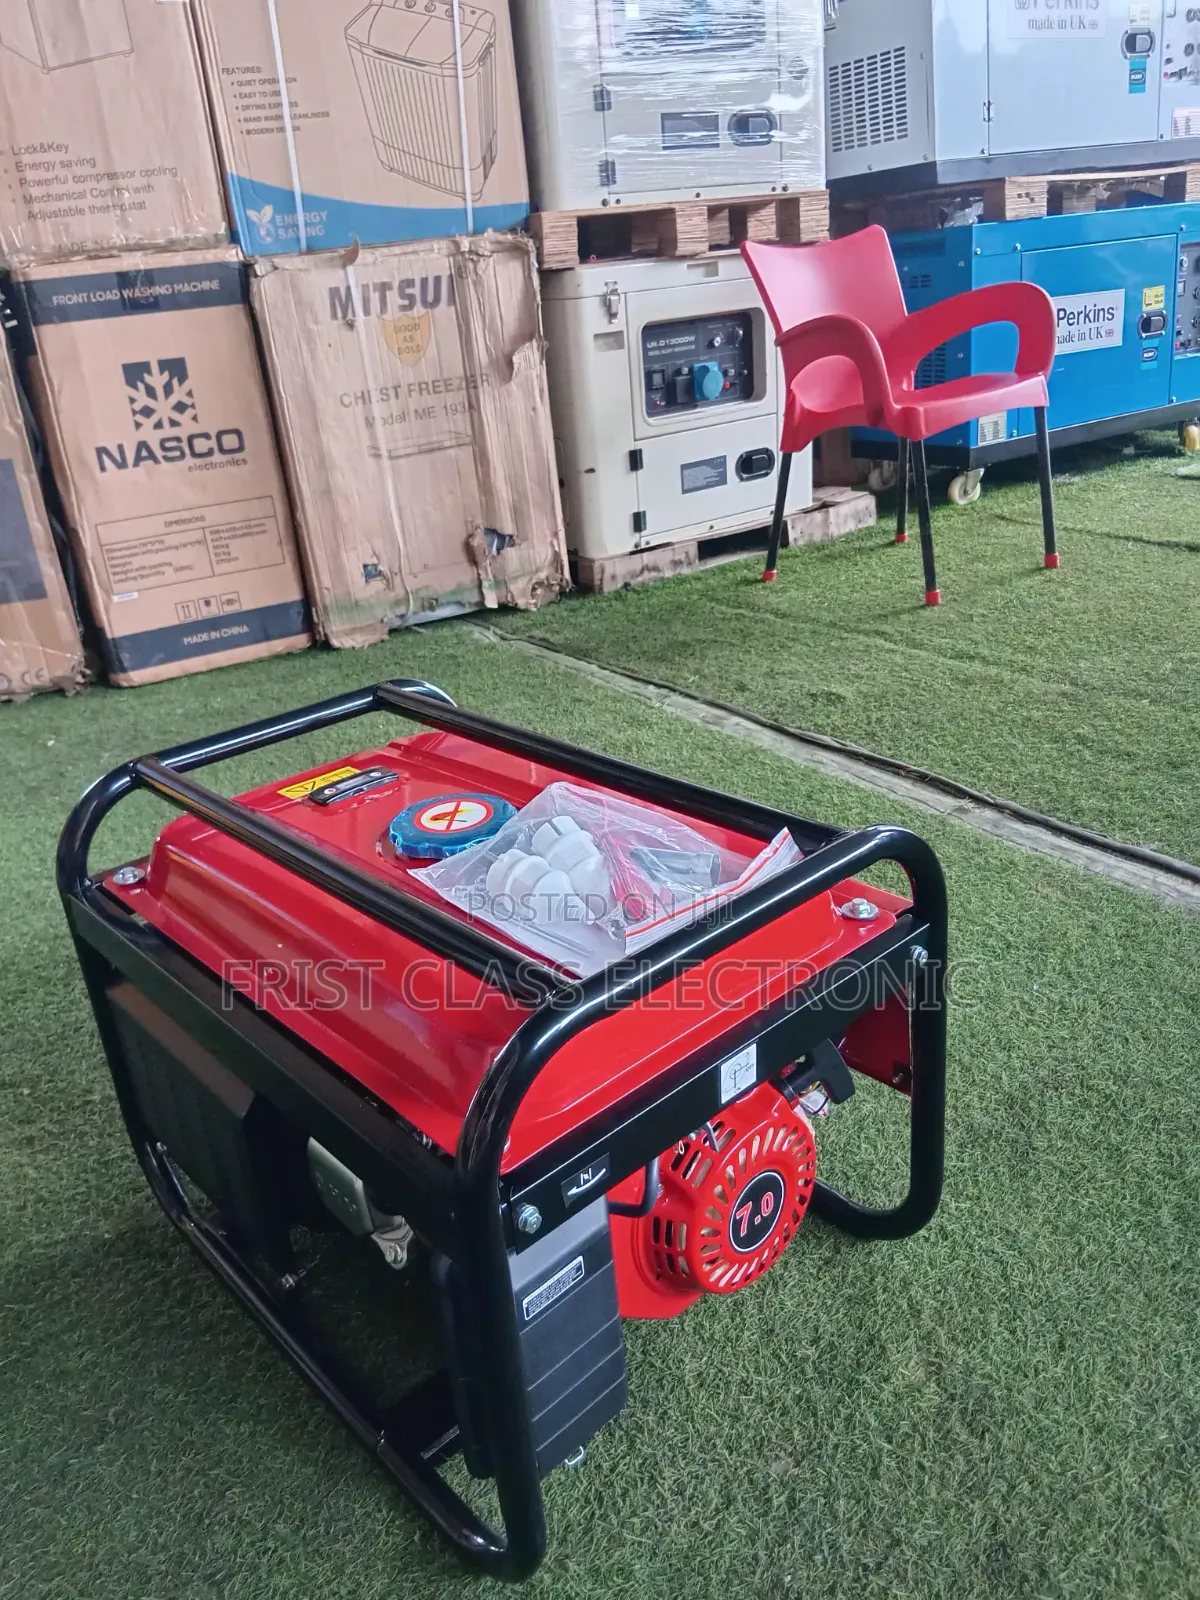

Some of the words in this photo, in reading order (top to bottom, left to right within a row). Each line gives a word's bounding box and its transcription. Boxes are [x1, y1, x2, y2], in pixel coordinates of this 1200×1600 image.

[1028, 15, 1055, 30] made
[1057, 15, 1067, 30] in
[1070, 14, 1086, 30] UK
[221, 66, 263, 75] FEATURES:
[236, 79, 256, 87] QUIET
[238, 91, 256, 99] EASY
[243, 115, 262, 123] HAND
[290, 111, 330, 120] LEANLINESS
[11, 142, 69, 156] Lock&Key
[15, 159, 57, 173] Energy
[60, 156, 96, 168] saving
[19, 174, 69, 189] Powerful
[72, 170, 136, 184] compressor
[140, 166, 178, 179] cooling
[23, 189, 87, 205] Mechanical
[133, 184, 155, 194] with
[27, 204, 86, 221] Adjustable
[278, 225, 325, 239] SAVNG
[51, 292, 88, 306] FRONT
[89, 289, 120, 303] LOAD
[121, 284, 173, 300] WASHING
[174, 280, 221, 293] MACHINE
[1056, 303, 1115, 328] Perkins
[1077, 329, 1086, 341] in
[1088, 326, 1103, 340] UK
[407, 373, 490, 398] FREEZER
[414, 406, 438, 420] ME
[95, 428, 246, 473] NASCO
[188, 457, 248, 473] electronics
[183, 632, 209, 645] MADE
[210, 629, 220, 640] IN
[221, 624, 250, 637] CHINA
[735, 1191, 774, 1238] 7.0
